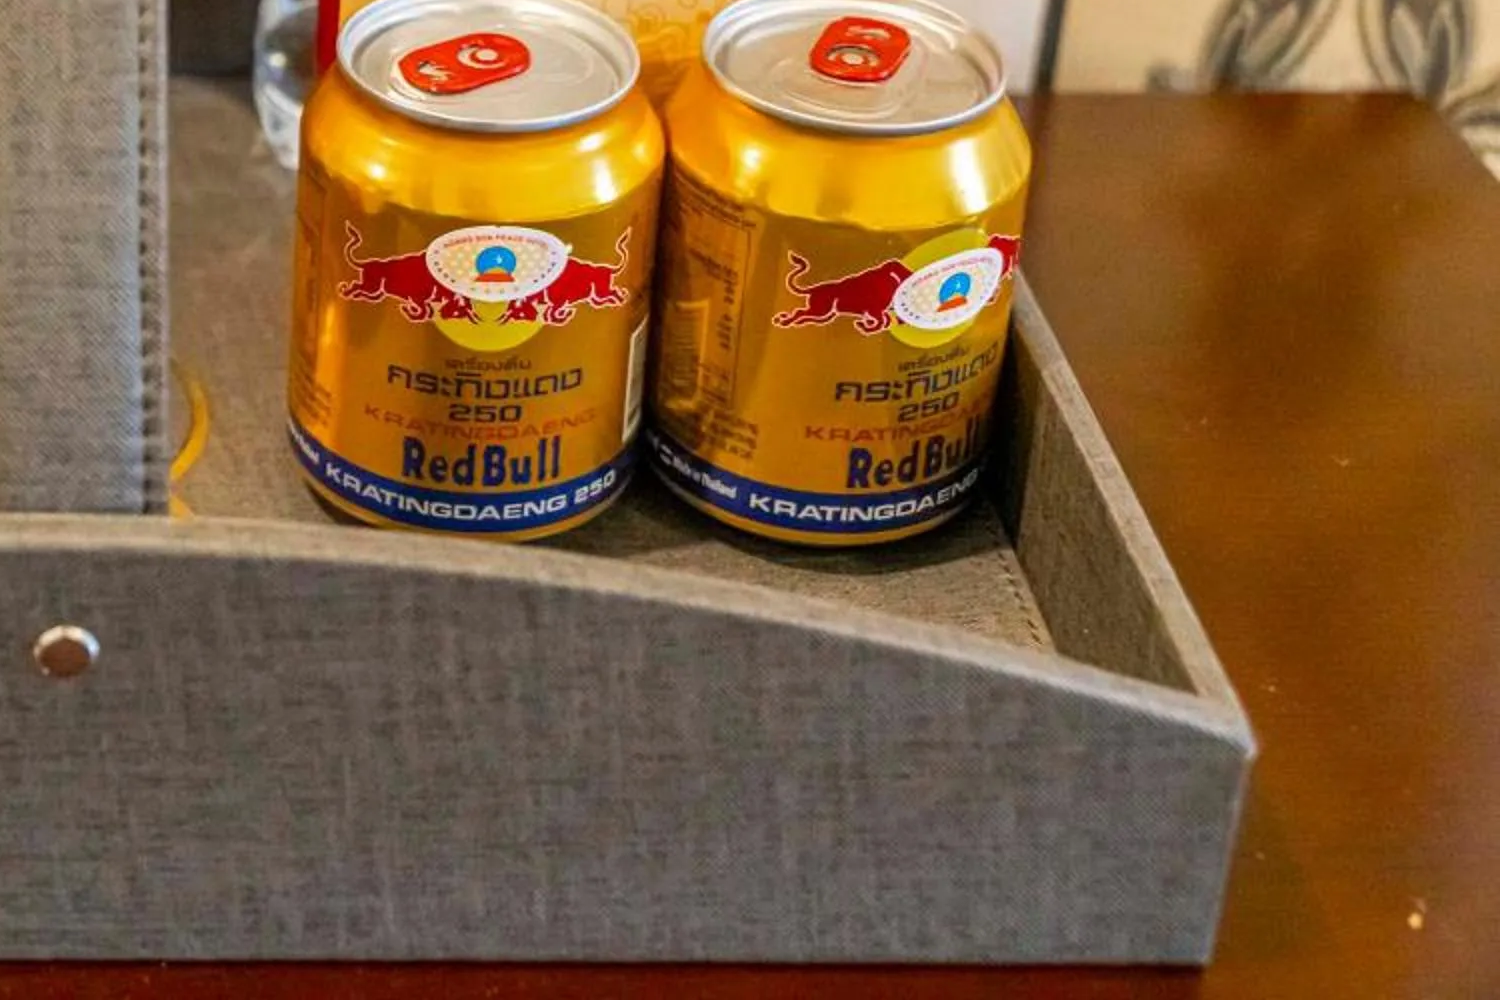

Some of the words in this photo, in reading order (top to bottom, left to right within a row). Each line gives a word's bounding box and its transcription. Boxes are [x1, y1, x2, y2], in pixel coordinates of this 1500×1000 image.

[363, 403, 599, 442] KRATINGDAENG
[449, 402, 523, 423] 250
[897, 391, 960, 423] 250
[325, 462, 568, 521] KRATINGDAENG
[573, 469, 618, 504] 250
[749, 467, 980, 523] KRATINGDAENG
